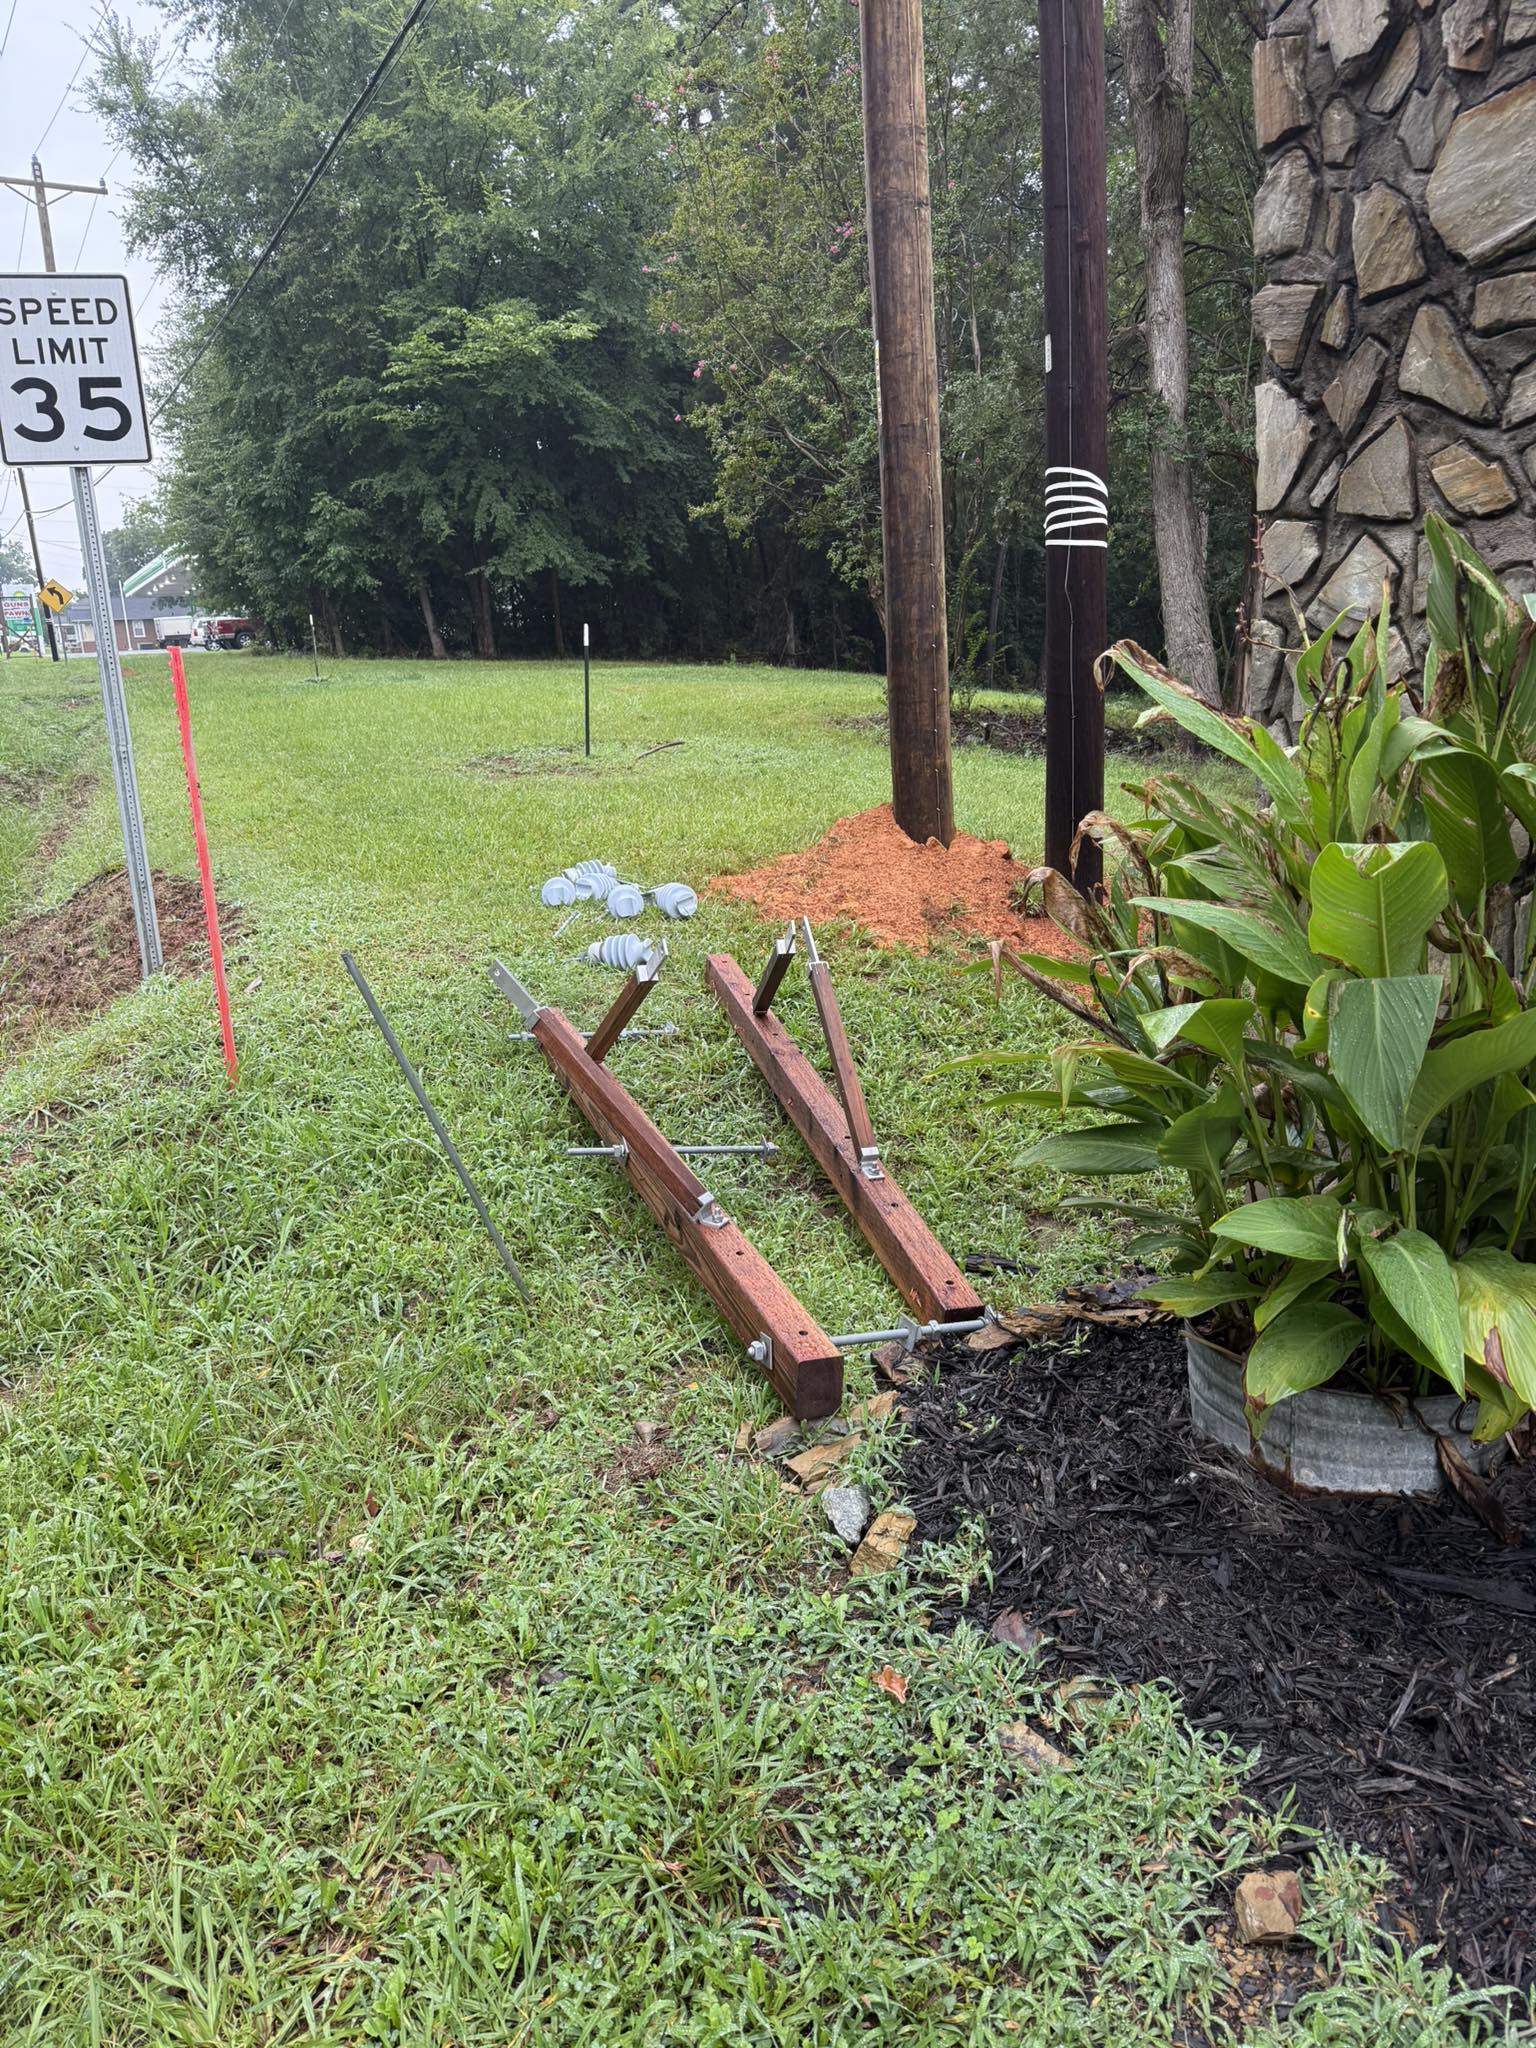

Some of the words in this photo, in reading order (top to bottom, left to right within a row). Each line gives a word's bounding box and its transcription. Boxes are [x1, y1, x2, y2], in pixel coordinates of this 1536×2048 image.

[0, 298, 118, 325] SPEED
[12, 337, 108, 365] LIMIT
[10, 376, 132, 443] 35
